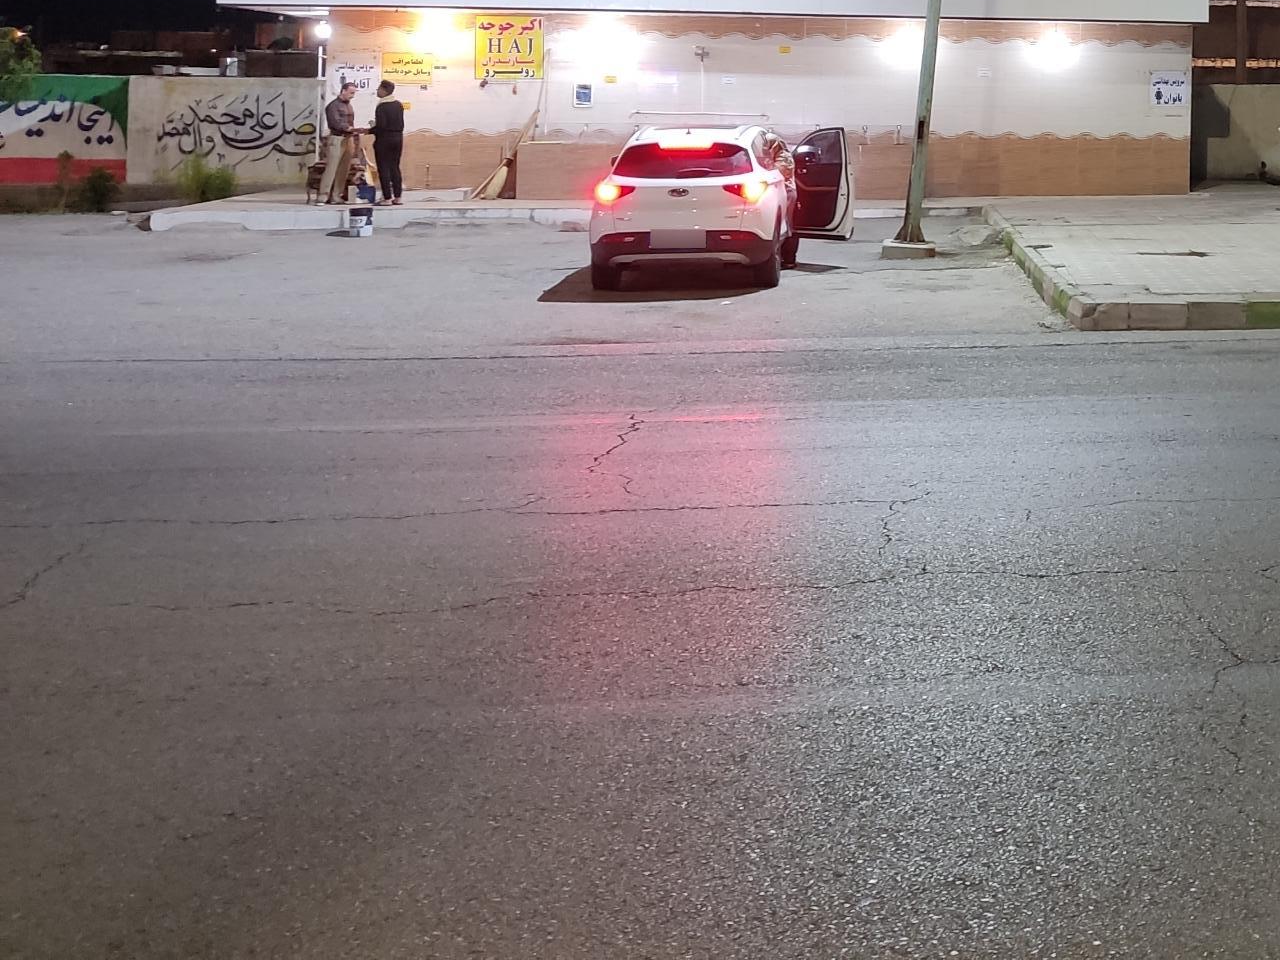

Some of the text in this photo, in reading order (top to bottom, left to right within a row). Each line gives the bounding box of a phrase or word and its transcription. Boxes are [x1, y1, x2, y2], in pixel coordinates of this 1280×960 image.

[478, 18, 542, 36] اکبر جوجه
[487, 37, 534, 57] HAJ
[353, 77, 373, 89] آقایا
[1163, 92, 1183, 105] بانوان
